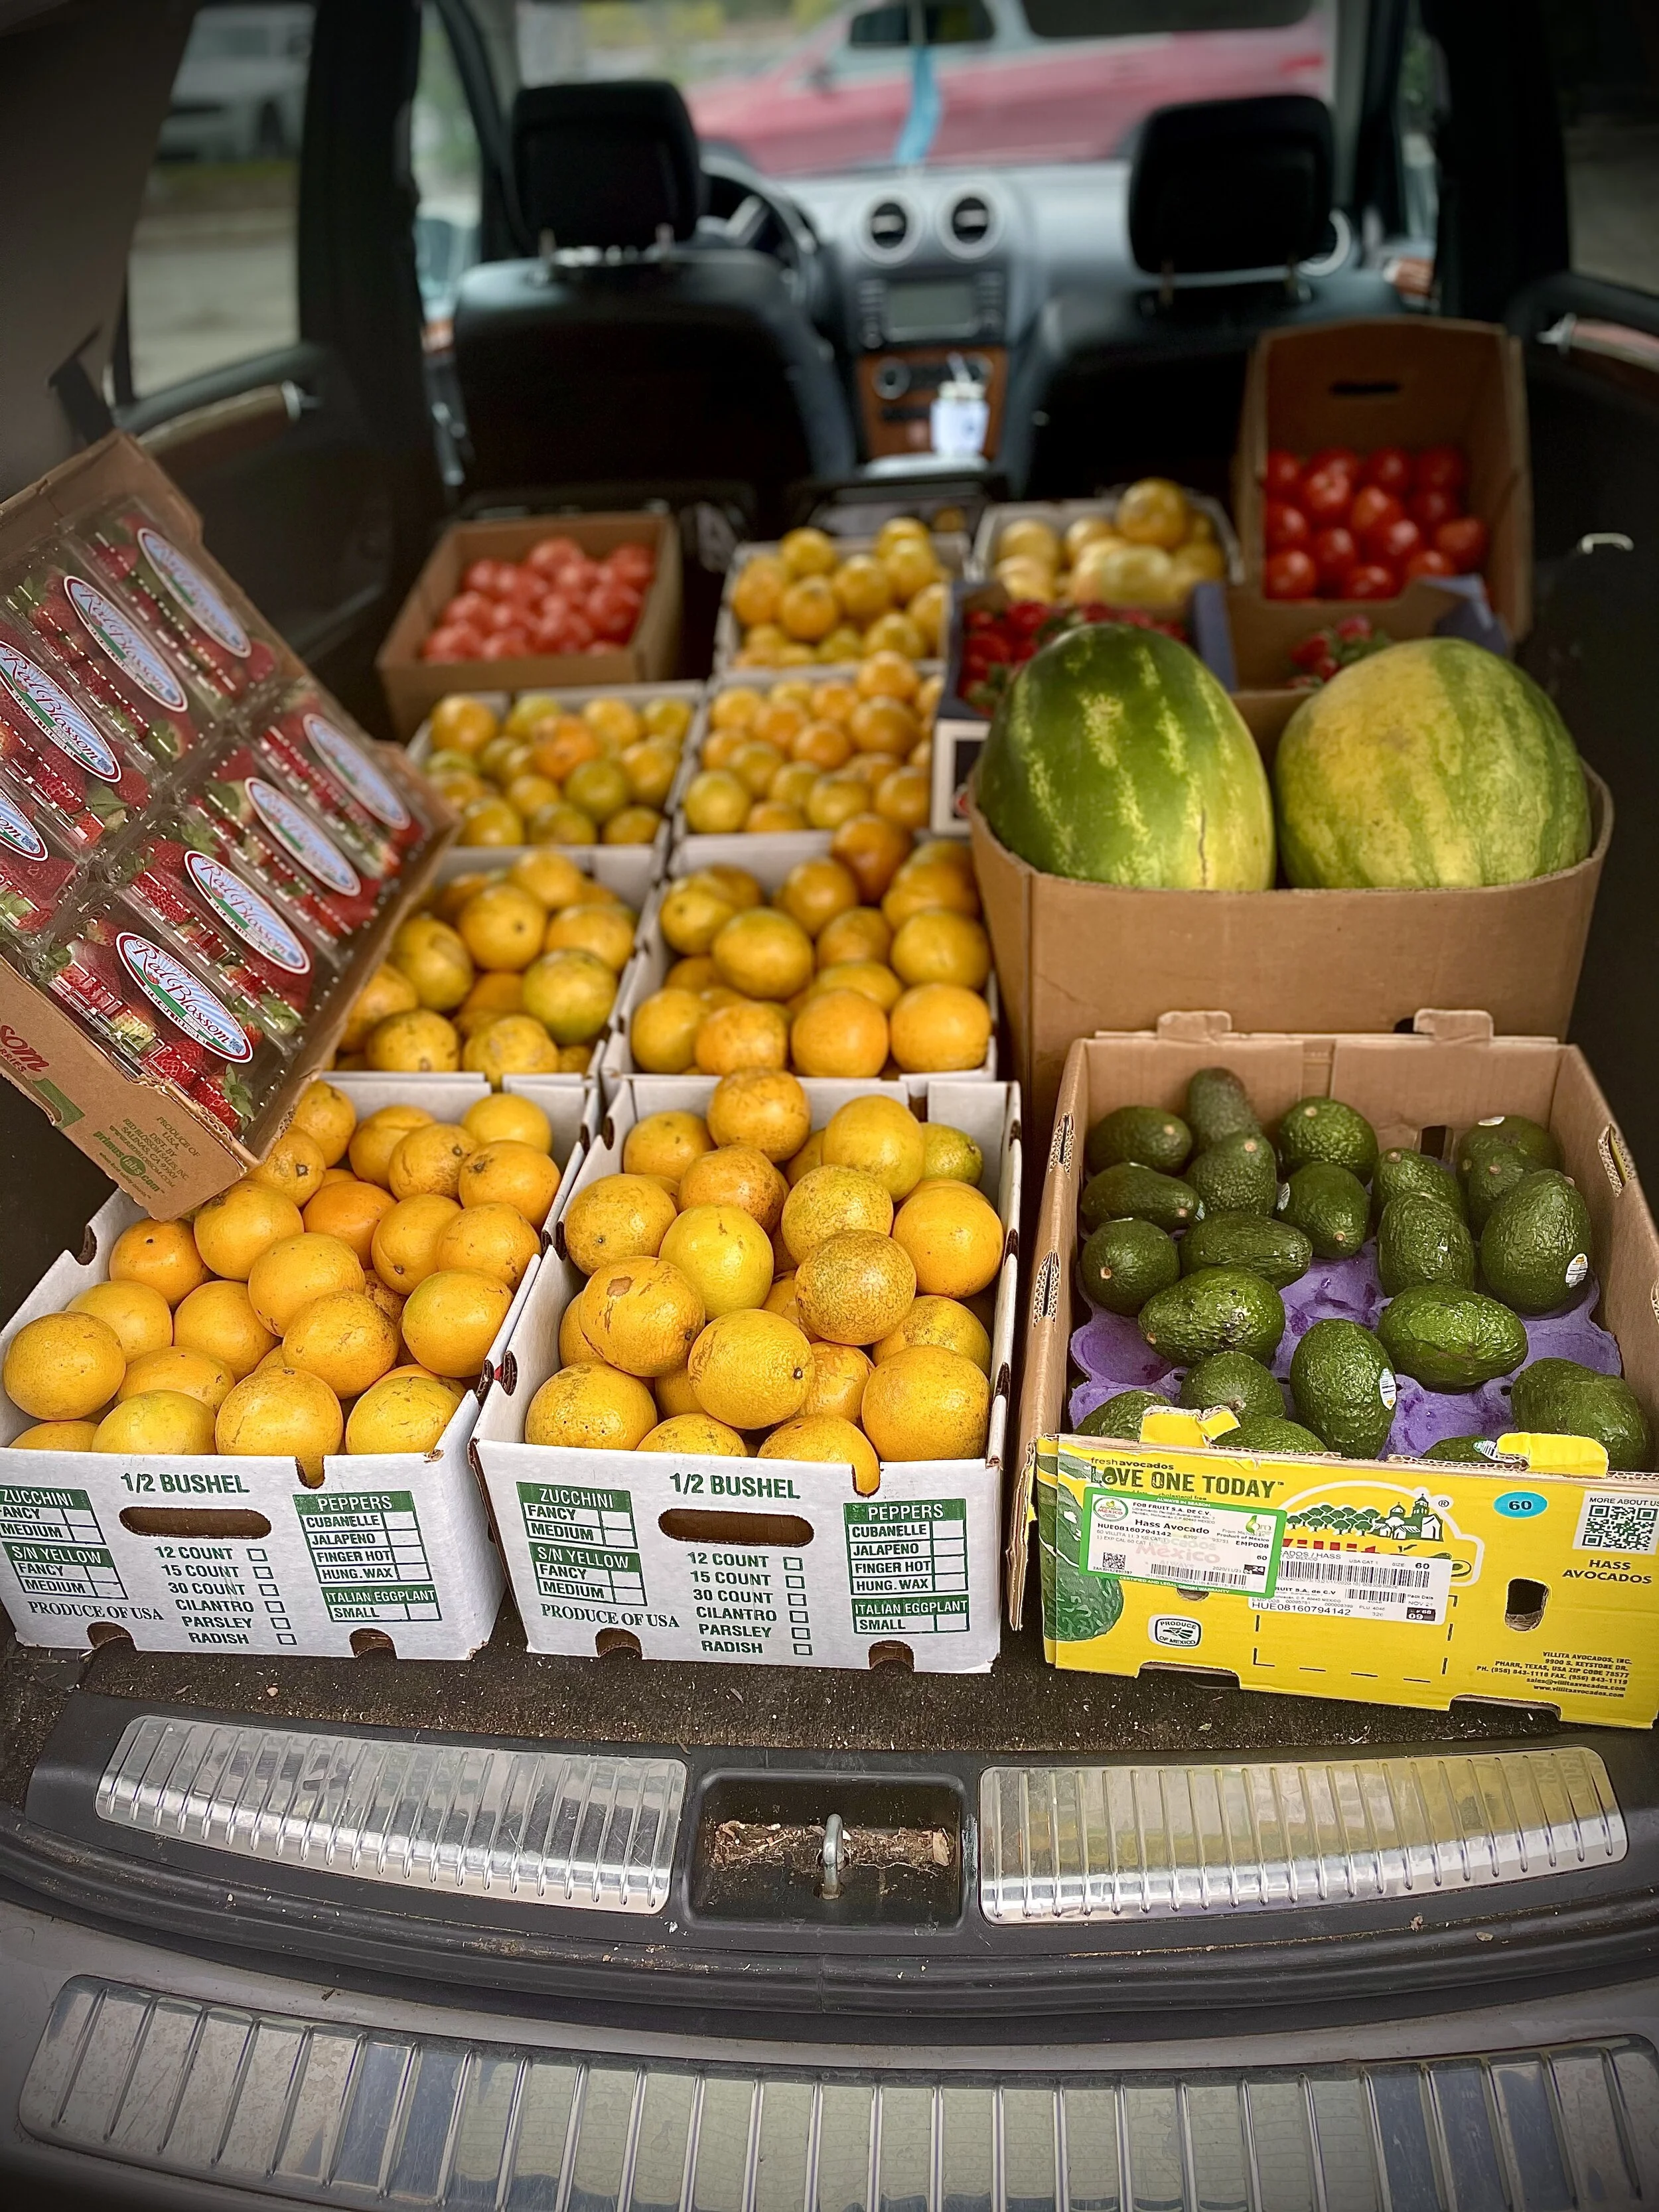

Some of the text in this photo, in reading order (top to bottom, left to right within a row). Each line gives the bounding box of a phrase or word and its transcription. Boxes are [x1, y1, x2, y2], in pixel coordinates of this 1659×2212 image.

[3, 649, 48, 692] Red
[35, 690, 98, 760] Blossom
[200, 858, 236, 895] Red
[132, 938, 178, 982] Red
[165, 978, 230, 1044] Blossom
[123, 1117, 161, 1155] RED BLOSSOM
[156, 1115, 201, 1158] PRODUCE OF
[149, 1152, 161, 1164] CA
[165, 1147, 177, 1159] BY
[120, 1473, 250, 1493] 1/2 BUSHEL
[670, 1473, 801, 1499] 1/2 BUSHEL
[1090, 1465, 1144, 1487] LOVE
[1151, 1471, 1196, 1492] ONE
[3, 1489, 74, 1507] ZUCCHINI
[317, 1496, 393, 1512] PEPPERS
[539, 1488, 614, 1509] ZUCCHINI
[527, 1505, 577, 1521] FANCY
[868, 1503, 944, 1521] PEPPERS
[1508, 1501, 1532, 1511] 60
[305, 1514, 380, 1528] CUBANELLE
[1135, 1519, 1210, 1534] Hass Avocado
[0, 1523, 64, 1538] MEDIUM
[531, 1522, 594, 1541] MEDIUM
[852, 1524, 927, 1538] CUBANELLE
[312, 1532, 376, 1546] JALAPENO
[1236, 1540, 1269, 1549] EMP008
[11, 1546, 102, 1564] S/N YELLOW
[154, 1546, 234, 1560] 12 COUNT
[316, 1550, 391, 1563] FINGER HOT
[853, 1543, 919, 1556] JALAPENO
[537, 1546, 628, 1569] S/N YELLOW
[687, 1552, 770, 1568] 12 COUNT
[1589, 1559, 1631, 1570] HASS
[17, 1562, 64, 1577] FANCY
[161, 1564, 239, 1578] 15 COUNT
[362, 1568, 394, 1579] WAX
[539, 1564, 587, 1580] FANCY
[855, 1560, 931, 1574] FINGER HOT
[689, 1570, 772, 1586] 15 COUNT
[856, 1578, 929, 1591] HUNG. WAX
[1561, 1570, 1652, 1584] AVOCADOS
[25, 1579, 86, 1593] MEDIUM
[167, 1582, 246, 1595] 30 COUNT
[543, 1581, 605, 1599] MEDIUM
[325, 1590, 435, 1603] ITALIAN EGGPLANT
[693, 1589, 774, 1604] 30 COUNT
[27, 1601, 165, 1620] PRODUCE OF USA
[175, 1599, 254, 1613] CILANTRO
[333, 1607, 380, 1619] SMALL
[696, 1606, 777, 1621] CILANTRO
[855, 1600, 968, 1615] ITALIAN EGGPLANT
[1252, 1601, 1351, 1616] HUE08160794142
[181, 1615, 252, 1629] PARSLEY
[540, 1603, 680, 1628] PRODUCE OF USA
[698, 1623, 772, 1638] PARSLEY
[859, 1619, 906, 1630] SMALL
[1160, 1621, 1197, 1630] PRODUCE
[188, 1632, 250, 1645] RADISH
[701, 1640, 763, 1654] RADISH
[1571, 1653, 1614, 1663] AVOCADOS,
[1575, 1660, 1613, 1670] KEYSTONE
[1494, 1660, 1523, 1669] PHARR,
[1524, 1662, 1550, 1672] TEXAS,
